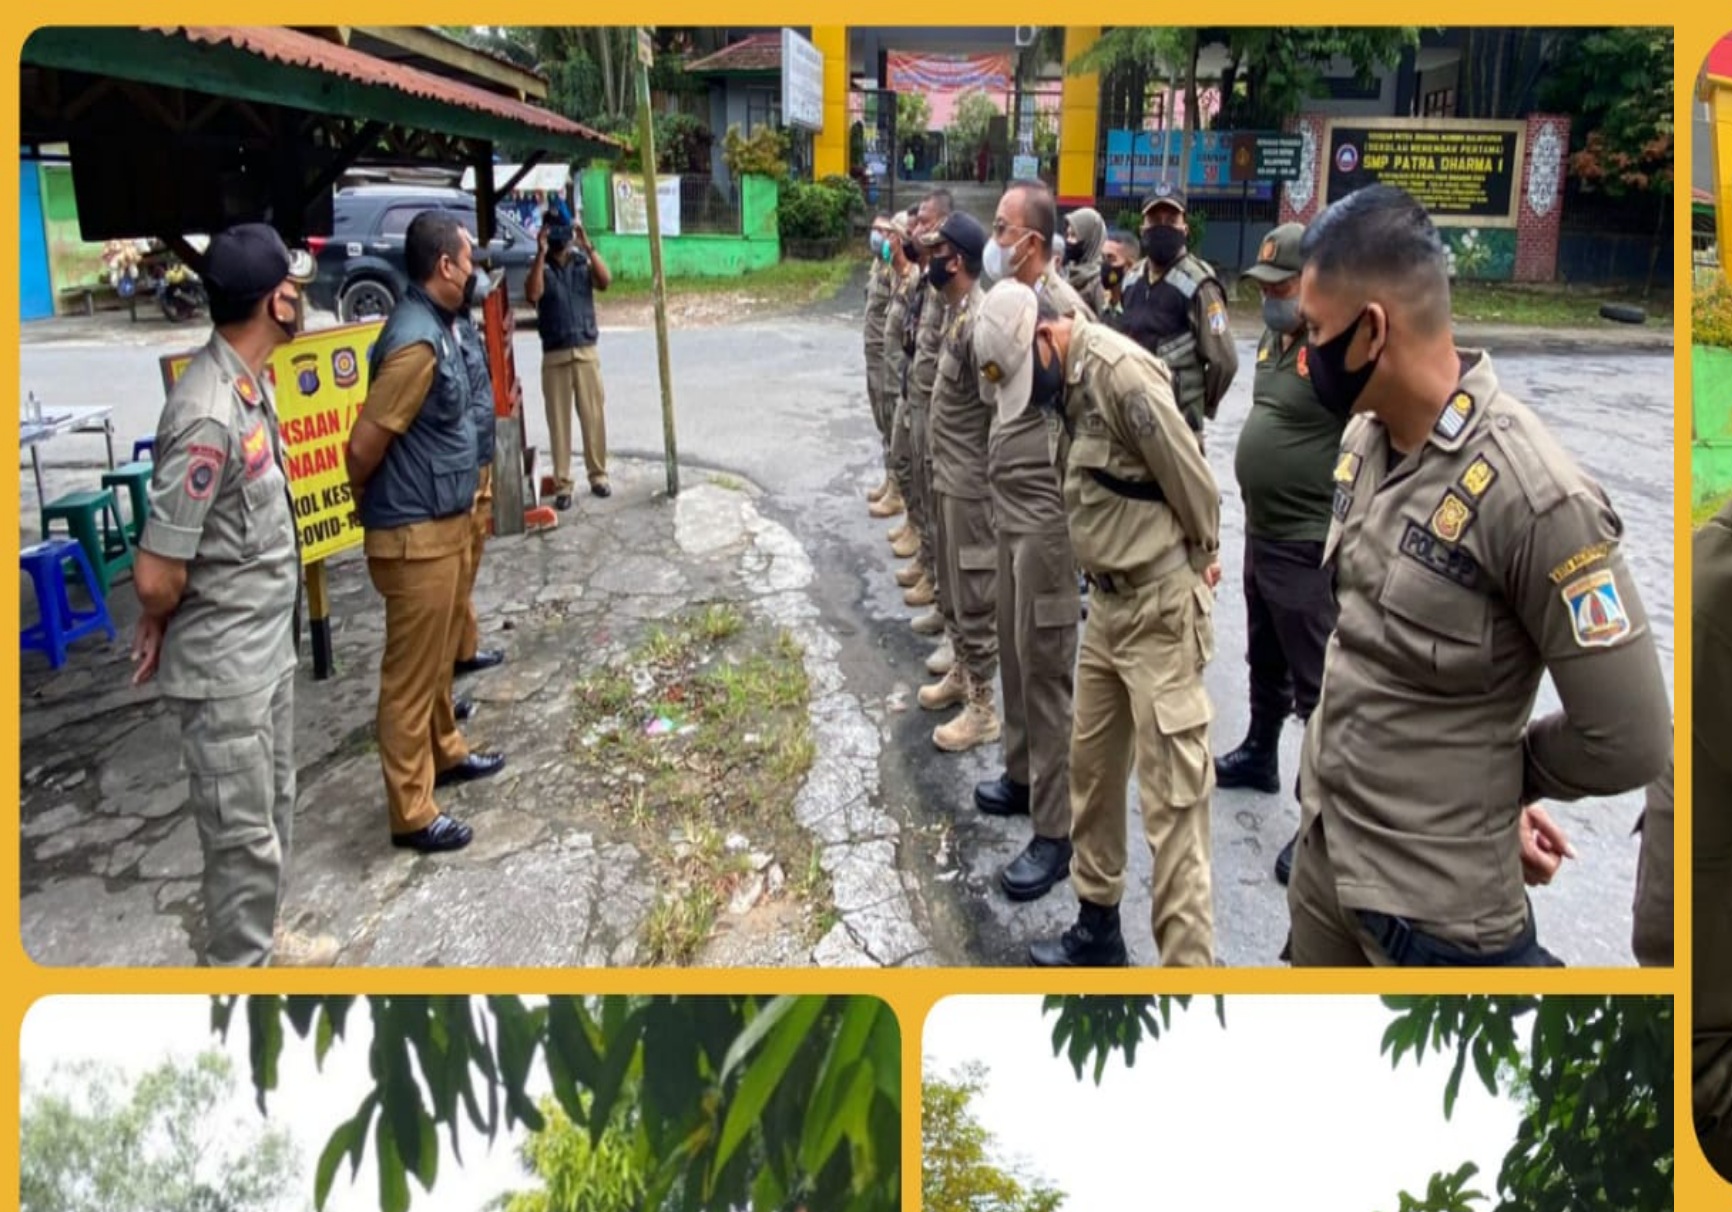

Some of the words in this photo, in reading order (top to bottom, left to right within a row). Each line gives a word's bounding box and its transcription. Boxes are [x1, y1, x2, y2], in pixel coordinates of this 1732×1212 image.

[1363, 155, 1388, 169] SMP
[1394, 156, 1435, 170] PATRA
[1440, 156, 1493, 173] DHARMA
